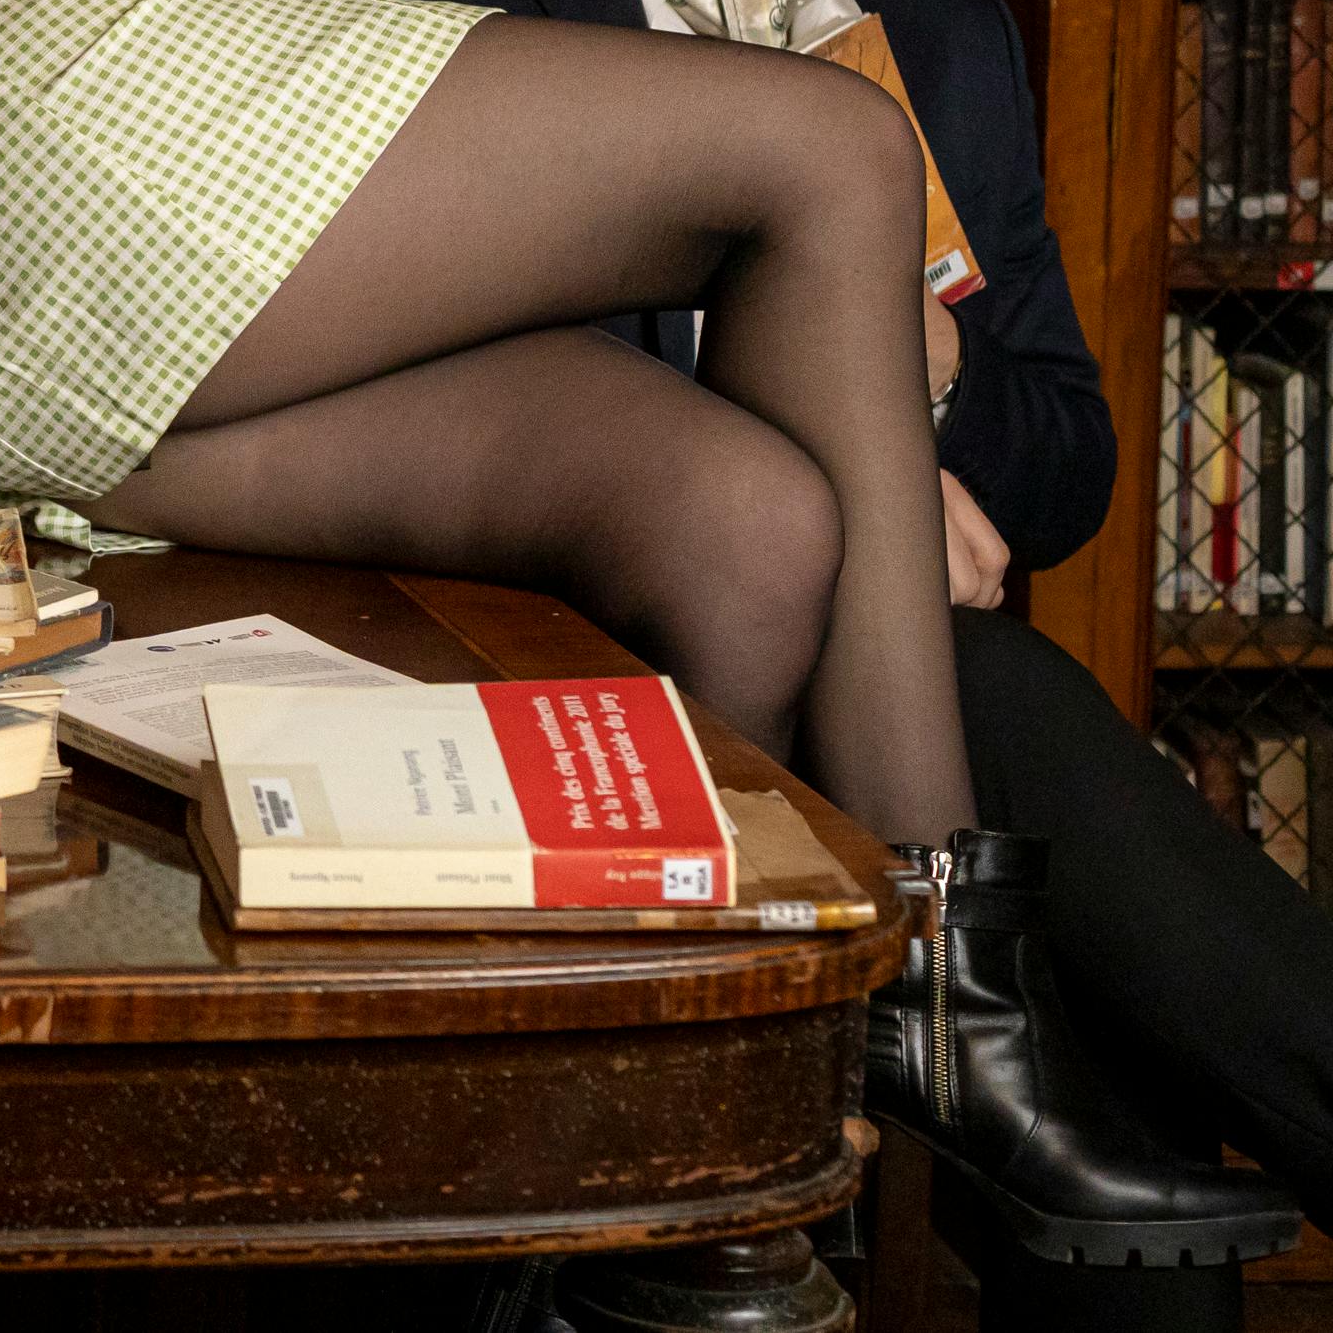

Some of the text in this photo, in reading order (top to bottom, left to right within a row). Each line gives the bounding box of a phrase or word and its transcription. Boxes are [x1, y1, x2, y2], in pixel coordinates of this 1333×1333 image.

[532, 696, 594, 829] Prix des cinq continents
[561, 695, 629, 830] de la Francophonie 2011
[598, 692, 662, 830] Mention spéciale du jury
